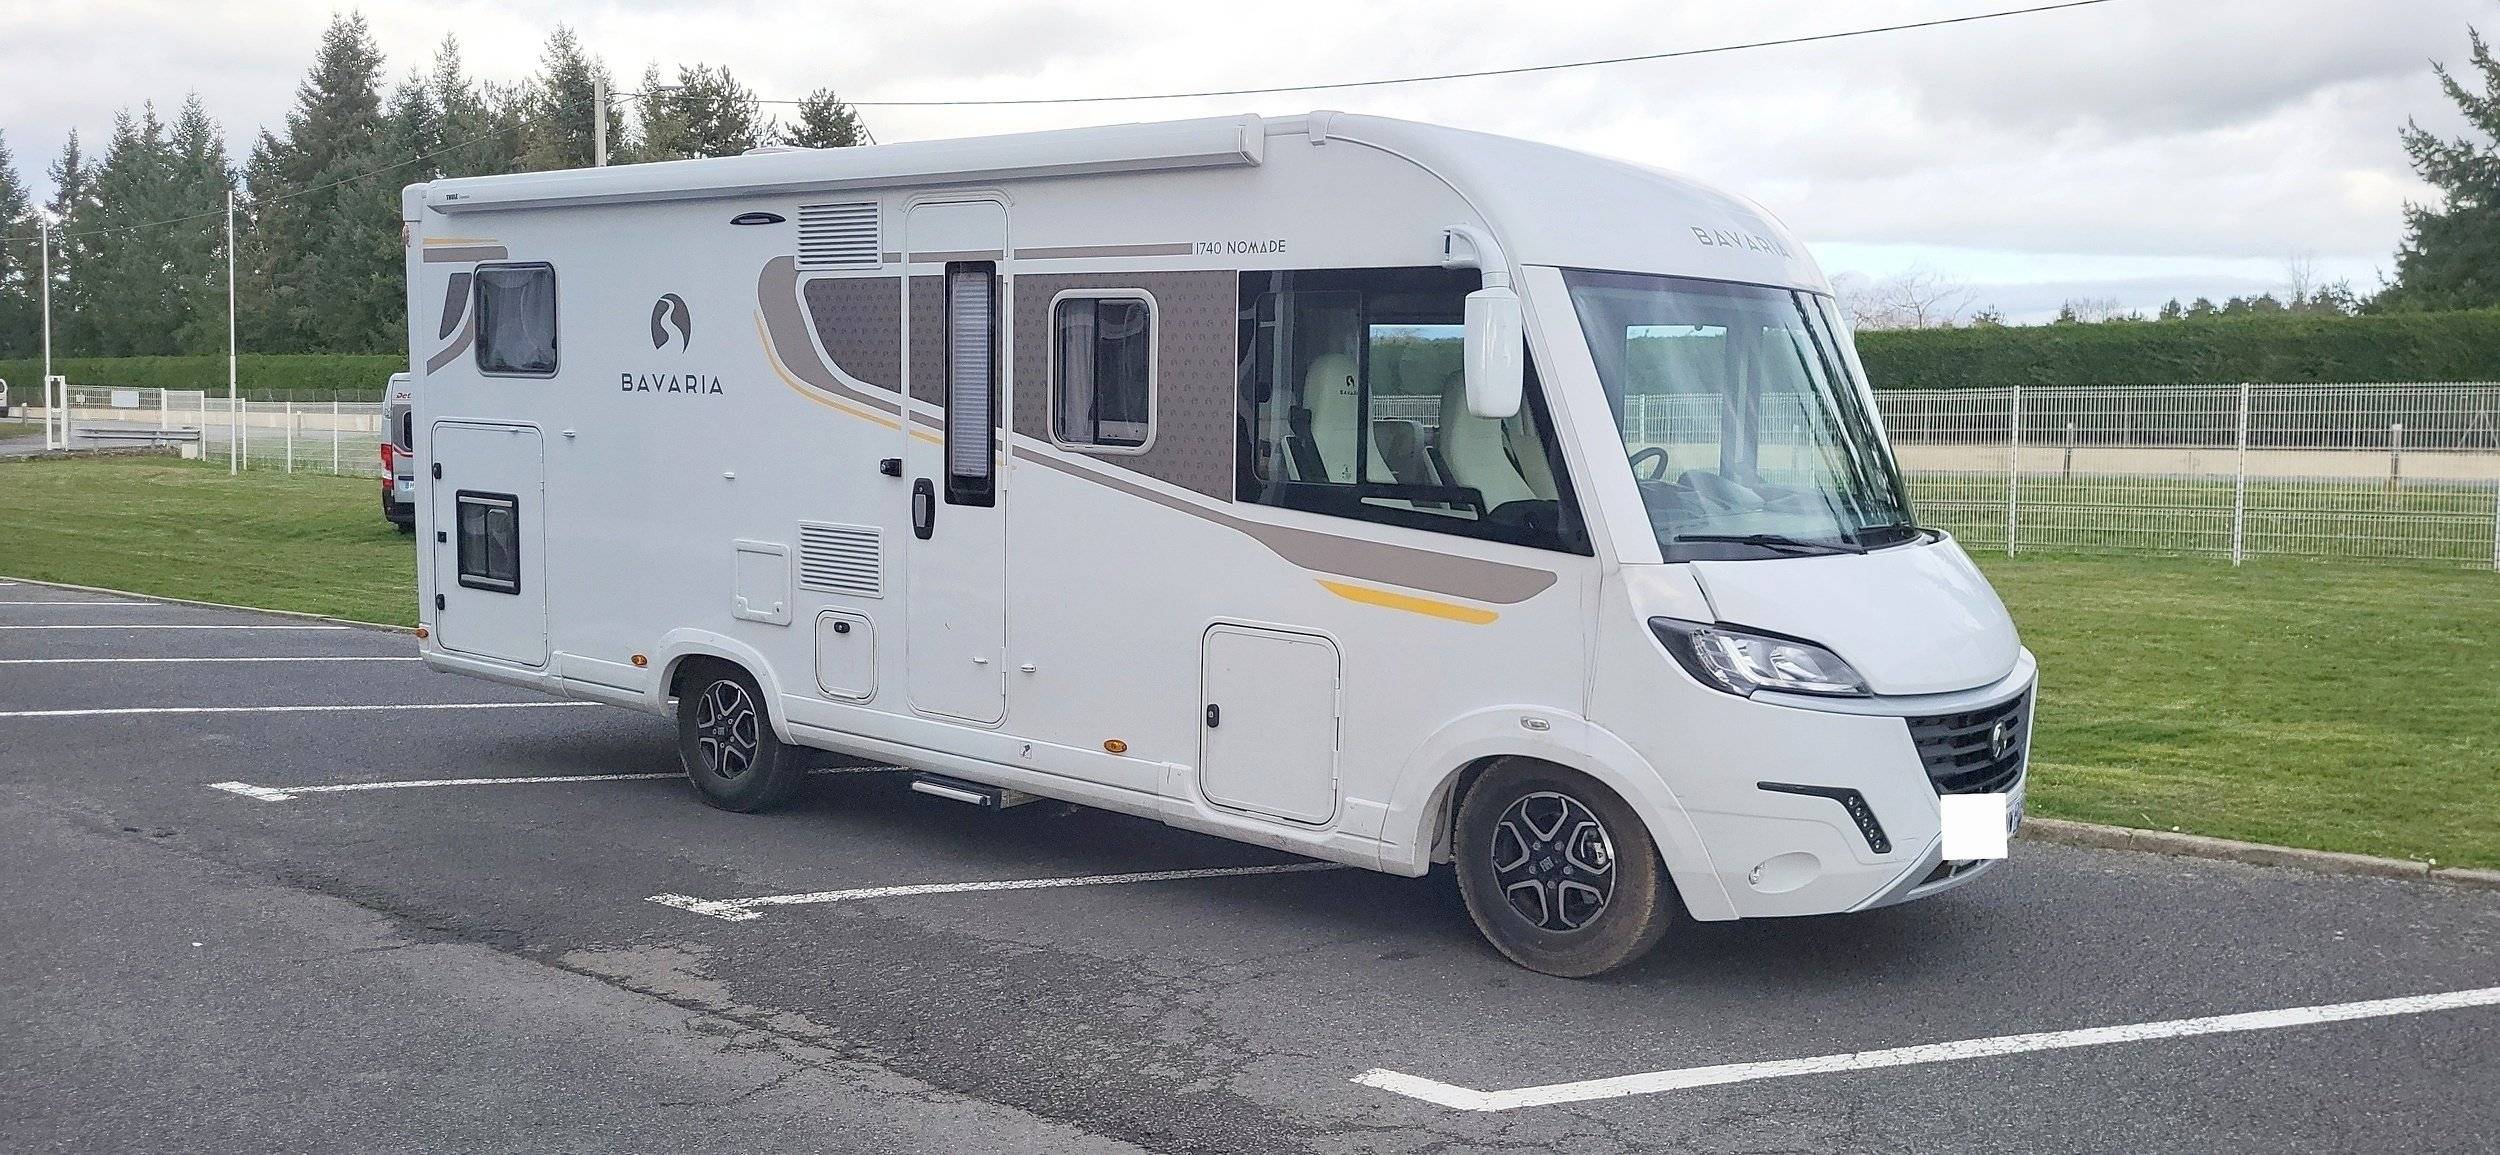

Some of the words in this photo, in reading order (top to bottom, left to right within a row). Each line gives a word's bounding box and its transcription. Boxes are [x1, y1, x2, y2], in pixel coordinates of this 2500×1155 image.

[1227, 240, 1286, 254] NOMADE
[1690, 226, 1793, 261] BAVARIA
[621, 372, 724, 395] BAVARIA
